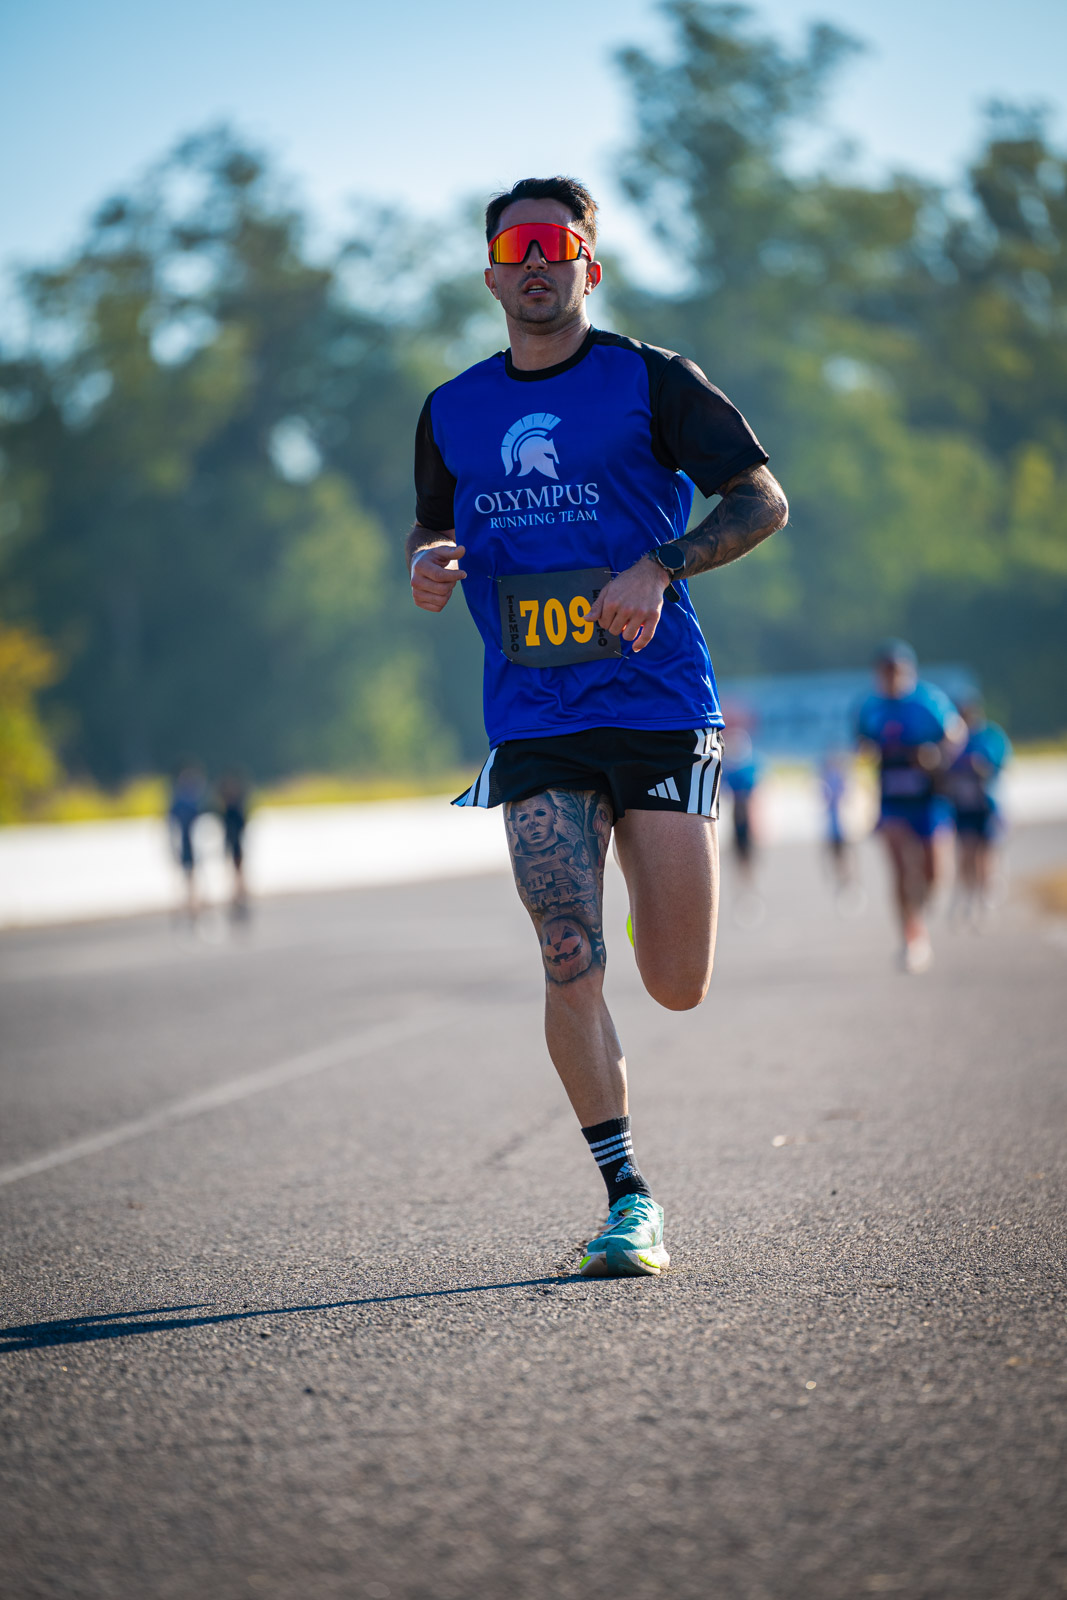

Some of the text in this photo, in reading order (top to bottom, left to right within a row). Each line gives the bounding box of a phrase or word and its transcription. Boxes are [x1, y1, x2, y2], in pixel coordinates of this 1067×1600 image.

[474, 482, 600, 514] OLYMPUS
[490, 510, 598, 529] RUNNING TEAM
[506, 595, 520, 653] TIEMPO
[519, 595, 594, 647] 709
